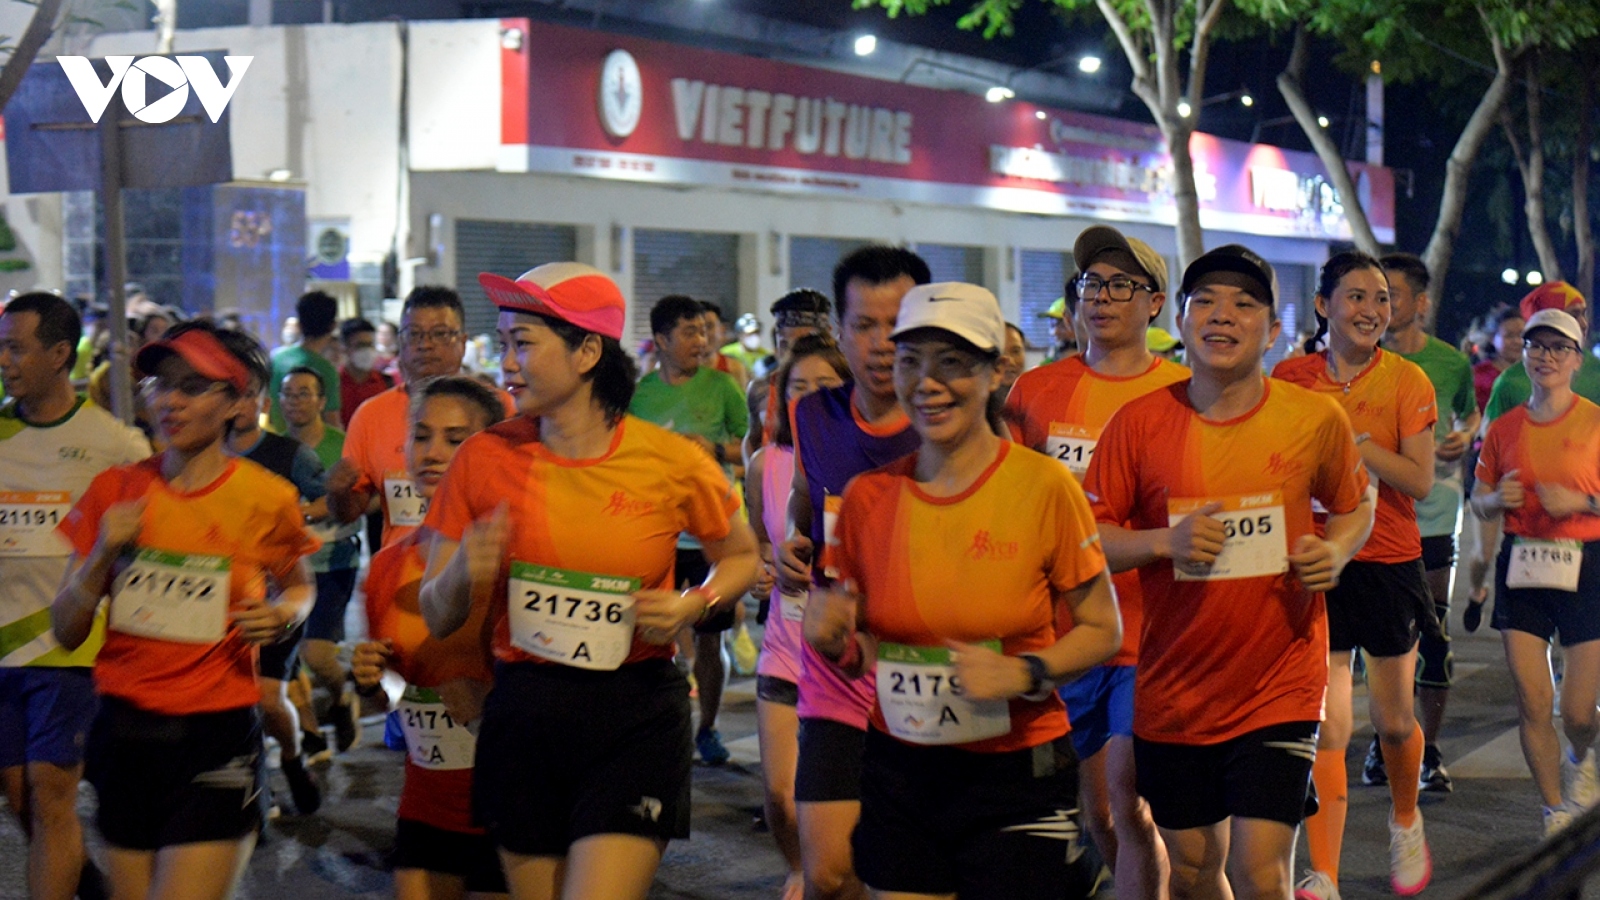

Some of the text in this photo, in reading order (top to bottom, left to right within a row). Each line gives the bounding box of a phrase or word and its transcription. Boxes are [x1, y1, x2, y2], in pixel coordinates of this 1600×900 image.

[671, 78, 912, 164] VIETFUTURE
[1057, 444, 1094, 462] 21
[0, 509, 58, 525] 21191
[591, 577, 630, 592] 21KM
[524, 591, 622, 624] 21736
[571, 642, 592, 662] A
[890, 671, 966, 696] 2179
[405, 708, 468, 729] 2171
[938, 705, 960, 727] A
[430, 745, 445, 763] A
